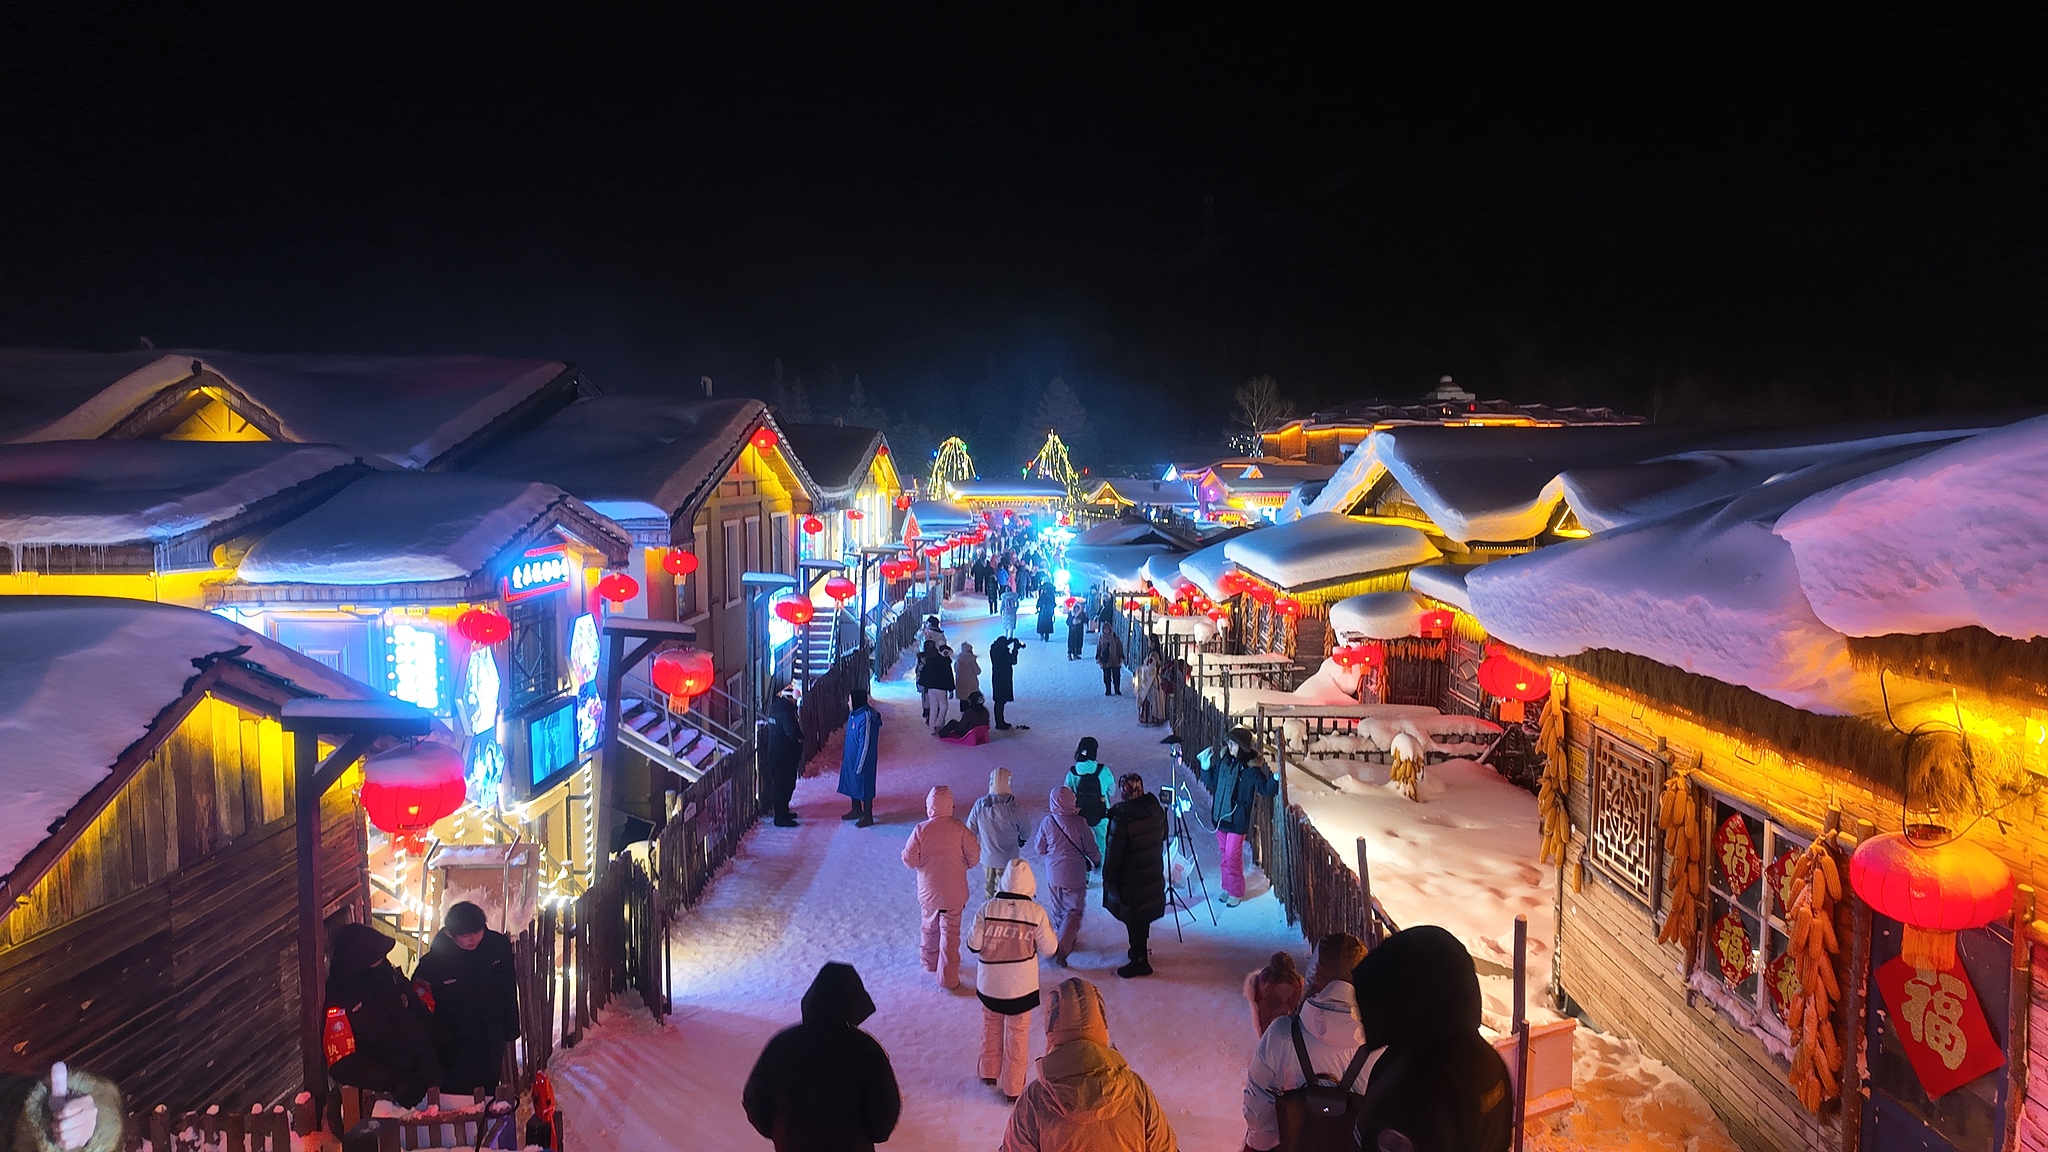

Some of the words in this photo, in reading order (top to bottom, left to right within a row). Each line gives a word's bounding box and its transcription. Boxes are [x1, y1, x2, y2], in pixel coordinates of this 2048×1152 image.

[1723, 826, 1749, 884] 福
[985, 925, 1034, 941] ARCTIC
[1718, 917, 1746, 973] 福
[1901, 967, 1967, 1070] 福
